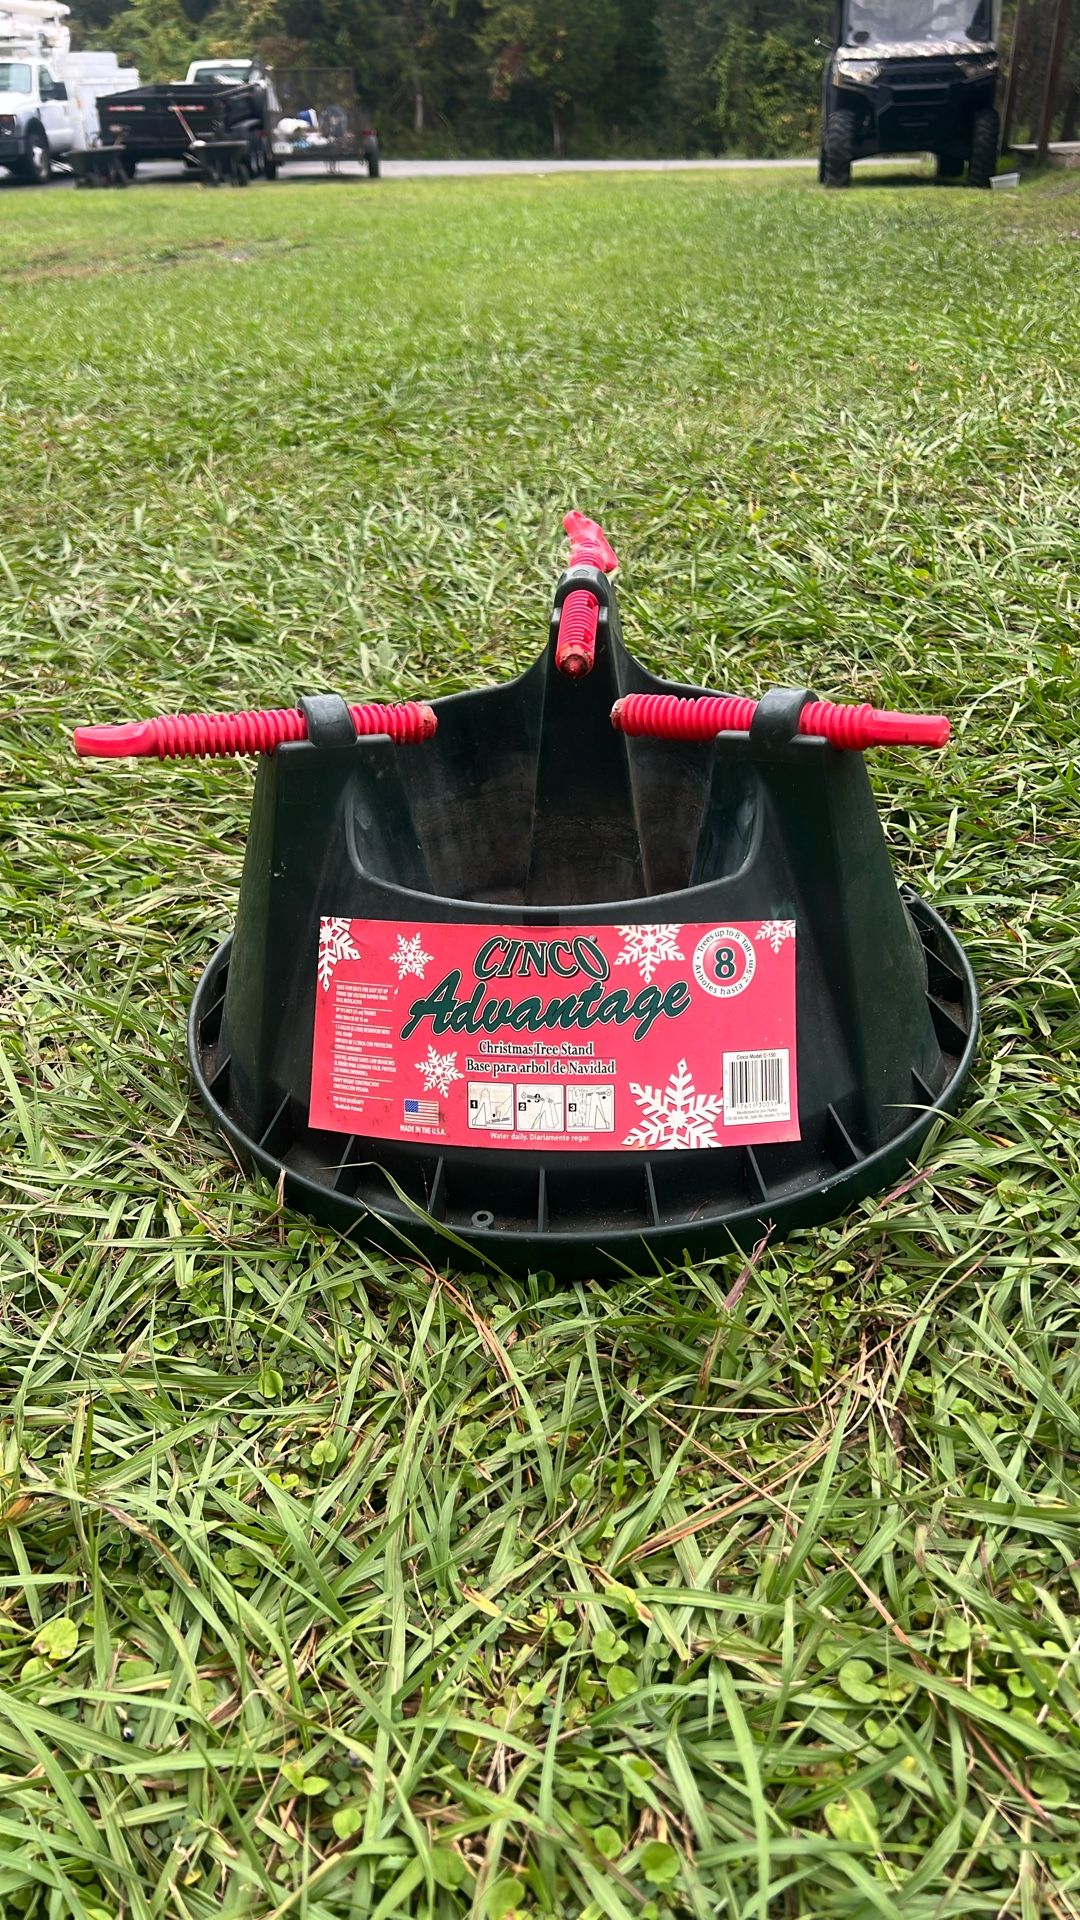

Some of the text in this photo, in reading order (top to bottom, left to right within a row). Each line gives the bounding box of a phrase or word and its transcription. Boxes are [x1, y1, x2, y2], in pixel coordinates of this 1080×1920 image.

[697, 933, 714, 952] Trees
[741, 938, 752, 952] Tall
[714, 948, 736, 979] 8
[694, 964, 717, 994] Arboles
[720, 983, 743, 995] hasta
[400, 968, 691, 1042] Advantage
[479, 1040, 594, 1056] Christmas Tree Stand
[466, 1059, 615, 1077] Base para arbol de Navidad
[400, 1124, 447, 1136] MADE IN THE U.S.A.
[511, 1132, 528, 1141] daily.
[530, 1133, 570, 1142] Diariamente
[571, 1135, 590, 1143] regar.
